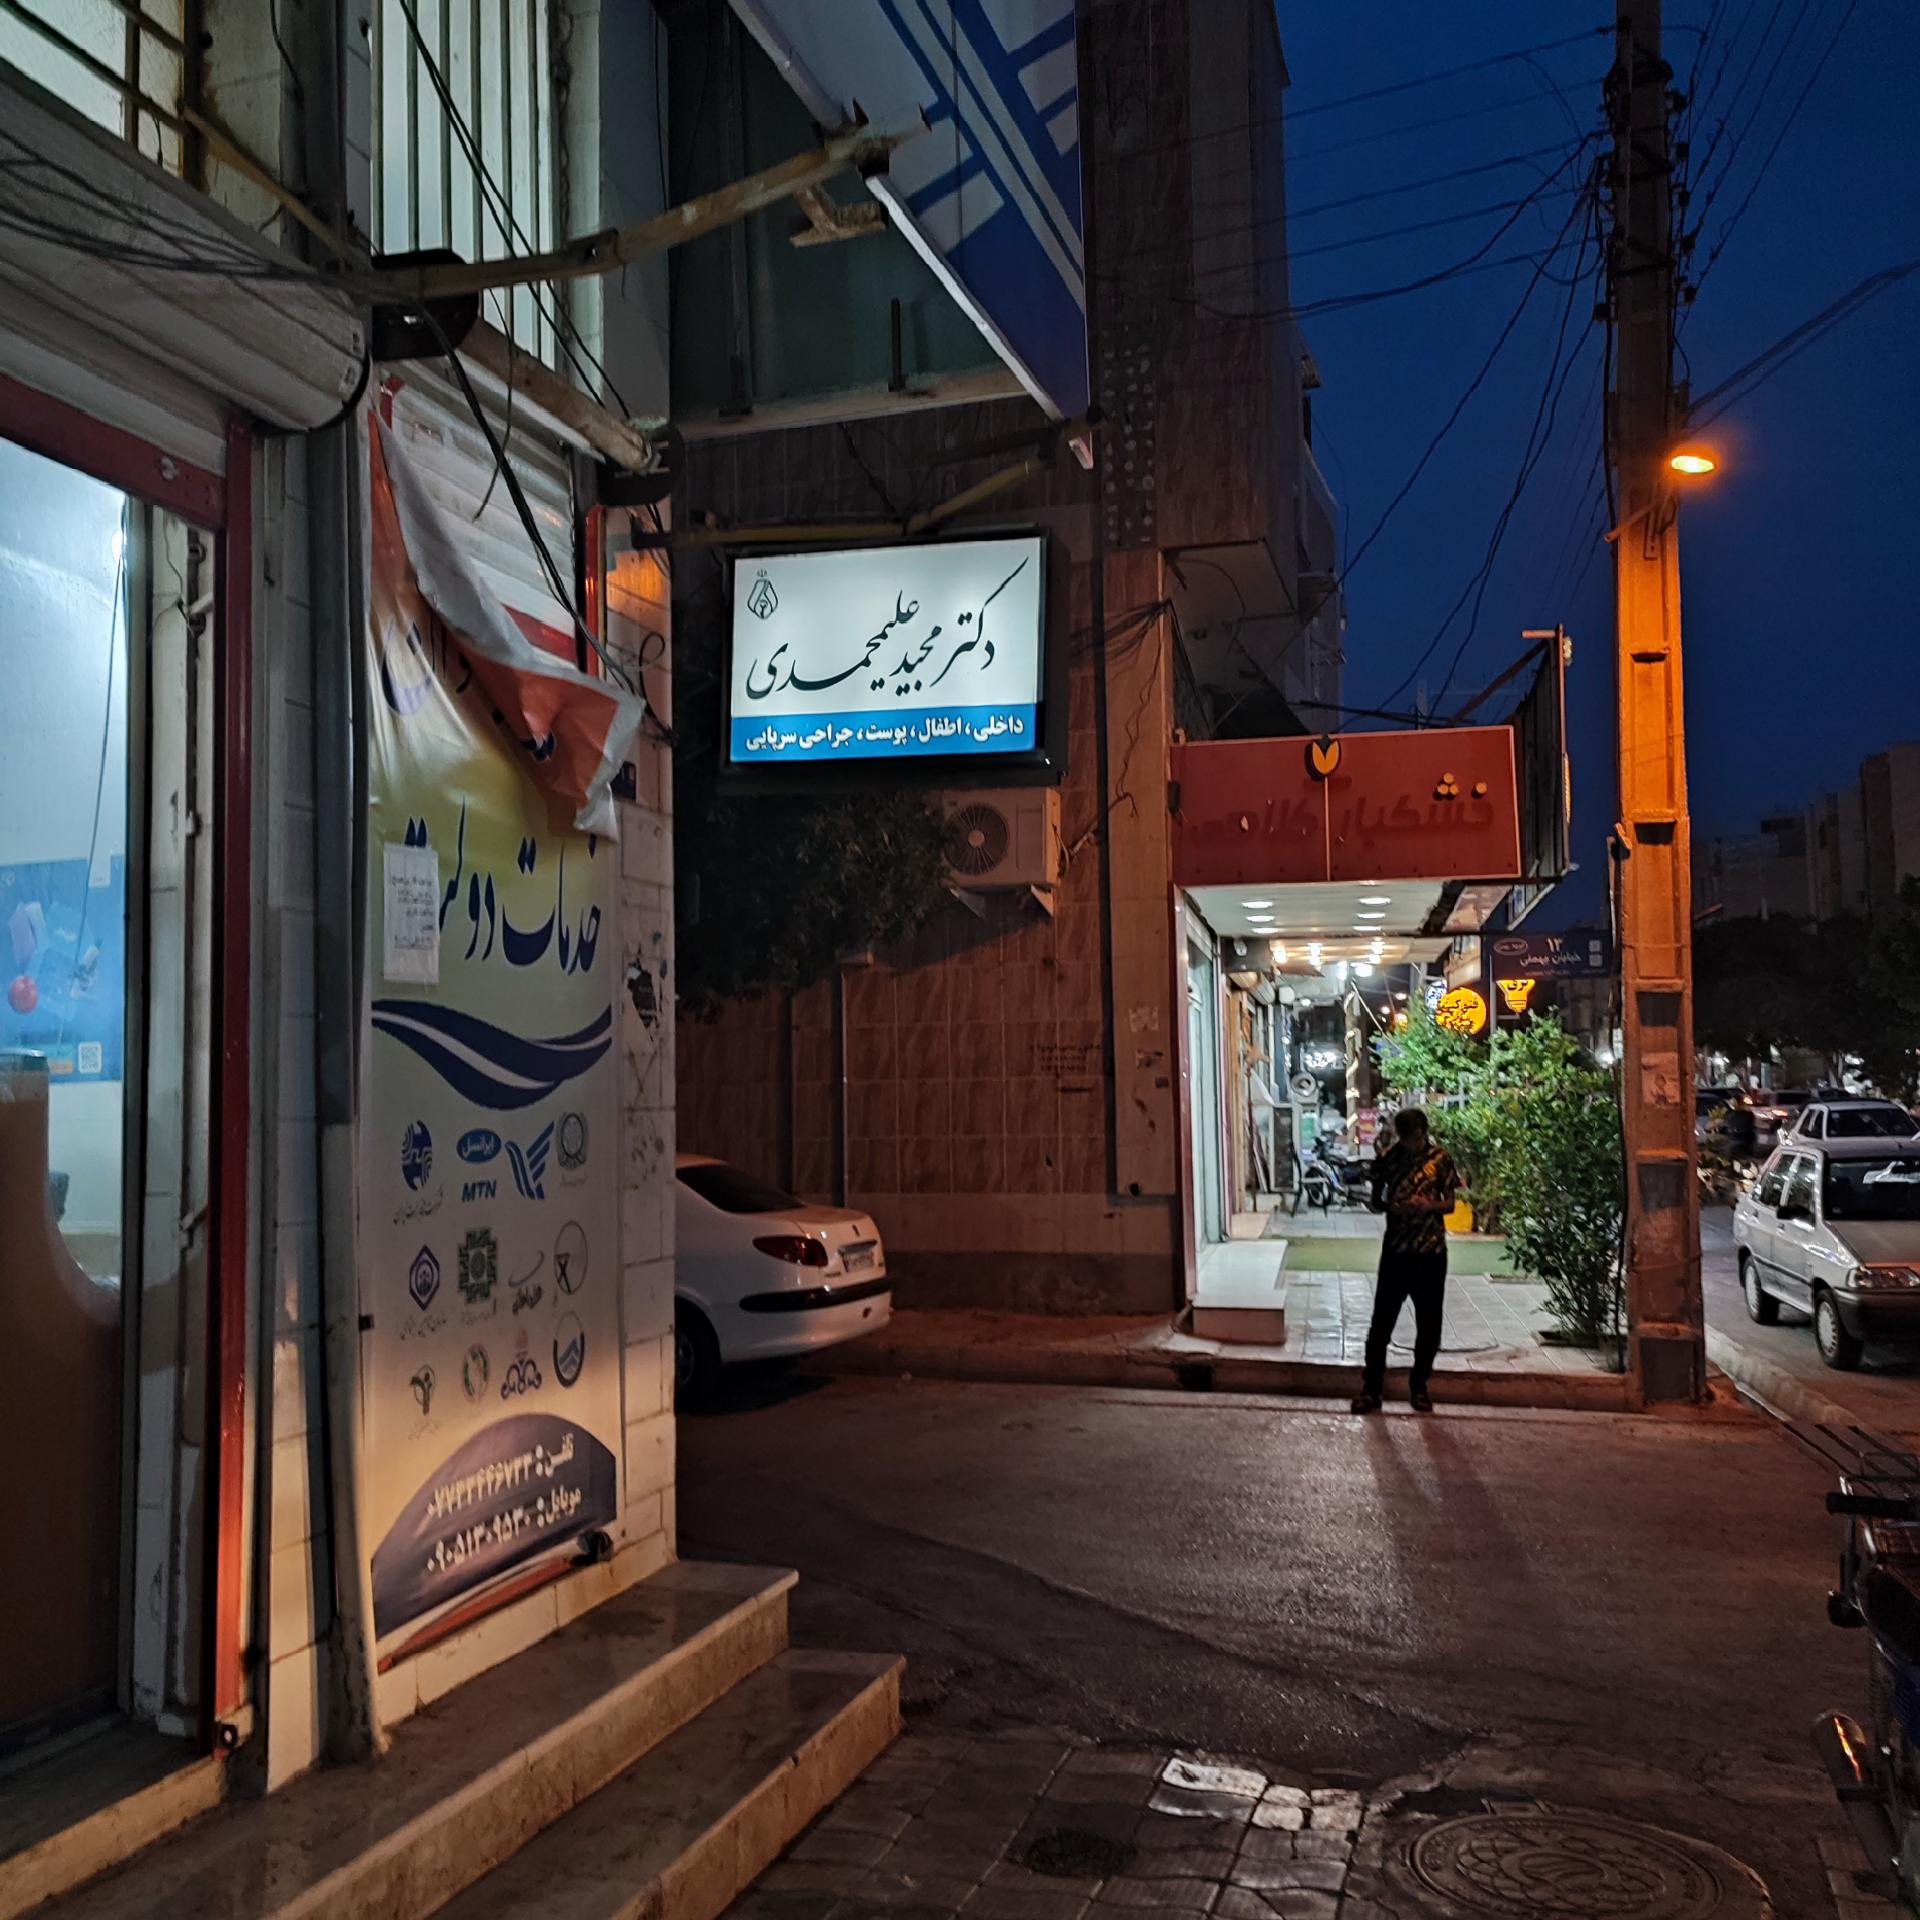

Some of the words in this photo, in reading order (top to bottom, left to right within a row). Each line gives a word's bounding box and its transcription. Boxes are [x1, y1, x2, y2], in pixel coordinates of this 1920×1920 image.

[930, 556, 1029, 688] دکتر
[889, 625, 943, 696] مجید
[745, 727, 798, 752] سرپایی
[798, 727, 853, 751] جراحی
[856, 723, 908, 746] پوست،
[910, 717, 962, 744] اطفال،
[965, 715, 1024, 743] داخلی،
[502, 834, 602, 975] خدمات
[461, 1180, 497, 1202] MTN
